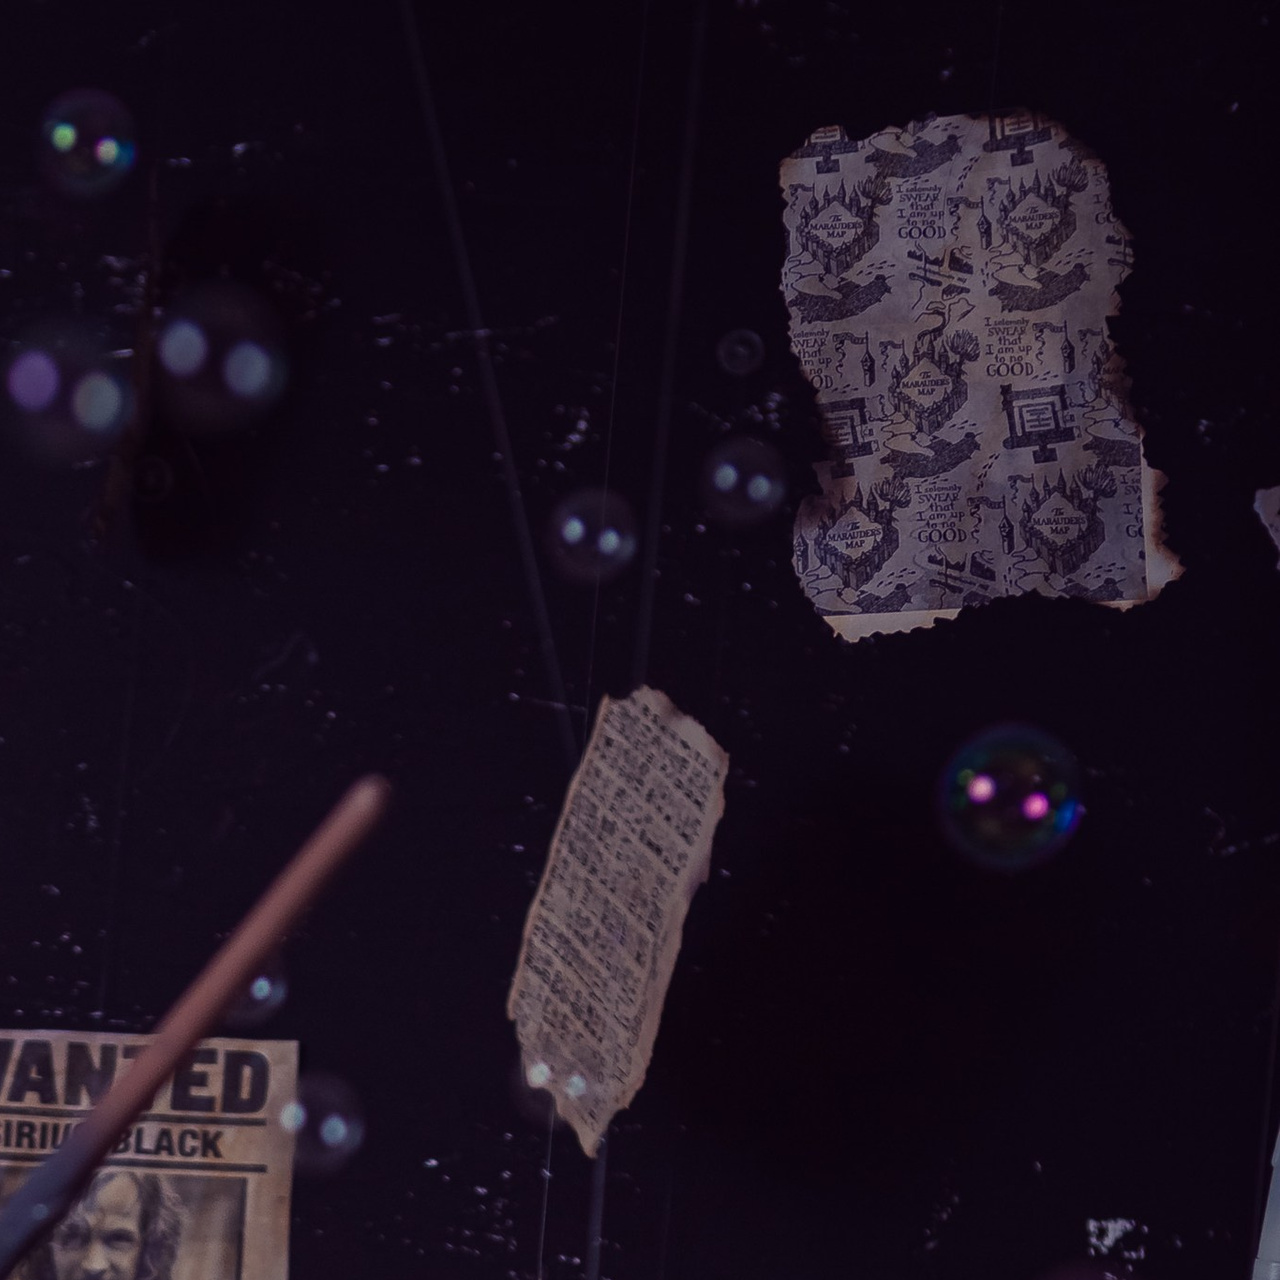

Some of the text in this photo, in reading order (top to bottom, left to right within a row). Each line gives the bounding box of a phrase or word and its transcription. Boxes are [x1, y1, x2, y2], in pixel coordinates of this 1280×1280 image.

[899, 193, 939, 202] SWEAR
[910, 201, 934, 210] that
[931, 210, 945, 220] up
[1025, 222, 1045, 230] MAP
[826, 230, 846, 238] MAP
[898, 226, 946, 239] GOOD
[988, 326, 1026, 337] SWEAR
[792, 339, 826, 348] WEAR
[998, 335, 1022, 345] that
[997, 346, 1014, 354] am
[1018, 345, 1032, 355] up
[986, 363, 1034, 377] GOOD
[918, 388, 936, 396] MAP
[918, 493, 959, 504] SWEAR
[929, 502, 955, 512] that
[929, 513, 947, 521] am
[951, 512, 965, 522] up
[1050, 526, 1070, 534] MAP
[918, 529, 967, 543] GOOD
[845, 540, 865, 549] MAP
